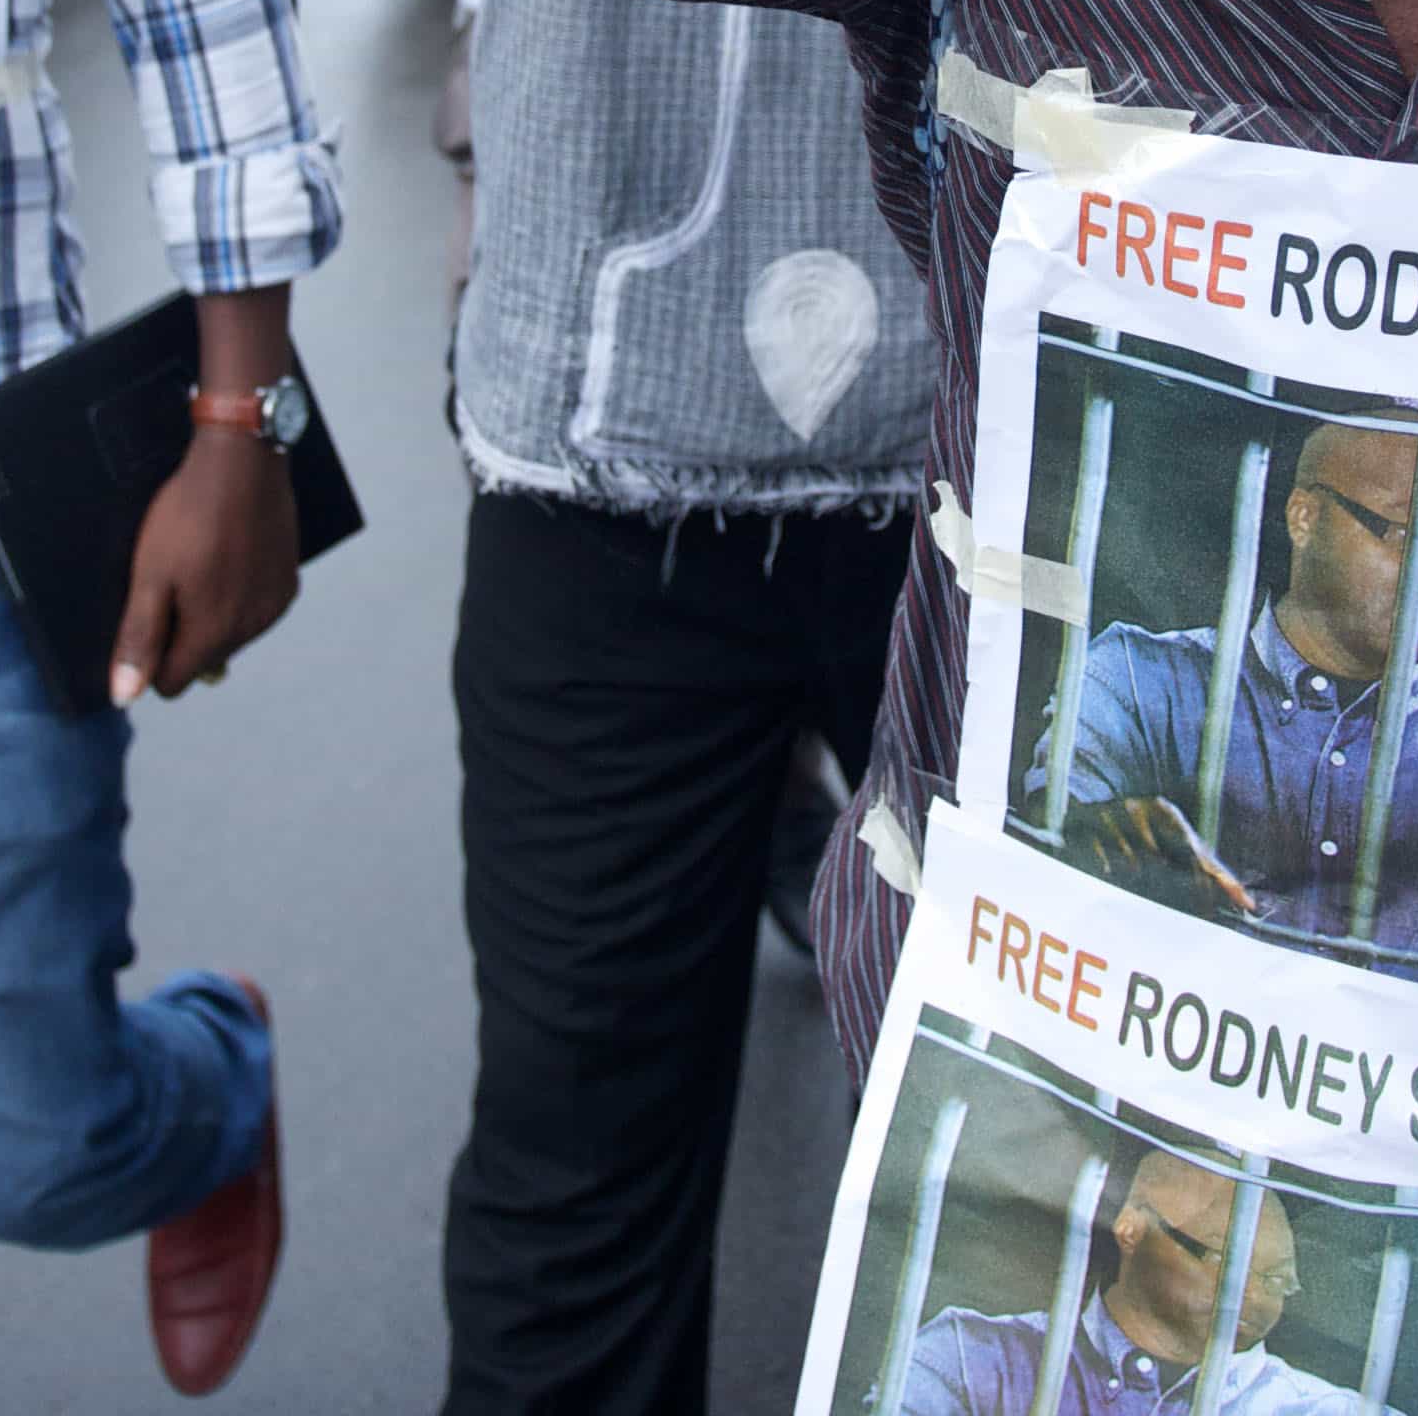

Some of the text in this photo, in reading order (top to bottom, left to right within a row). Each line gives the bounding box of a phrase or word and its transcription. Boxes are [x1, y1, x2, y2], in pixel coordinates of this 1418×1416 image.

[1077, 190, 1255, 311] FREE
[966, 894, 1108, 1033] FREE
[1118, 970, 1395, 1136] RODNEY
